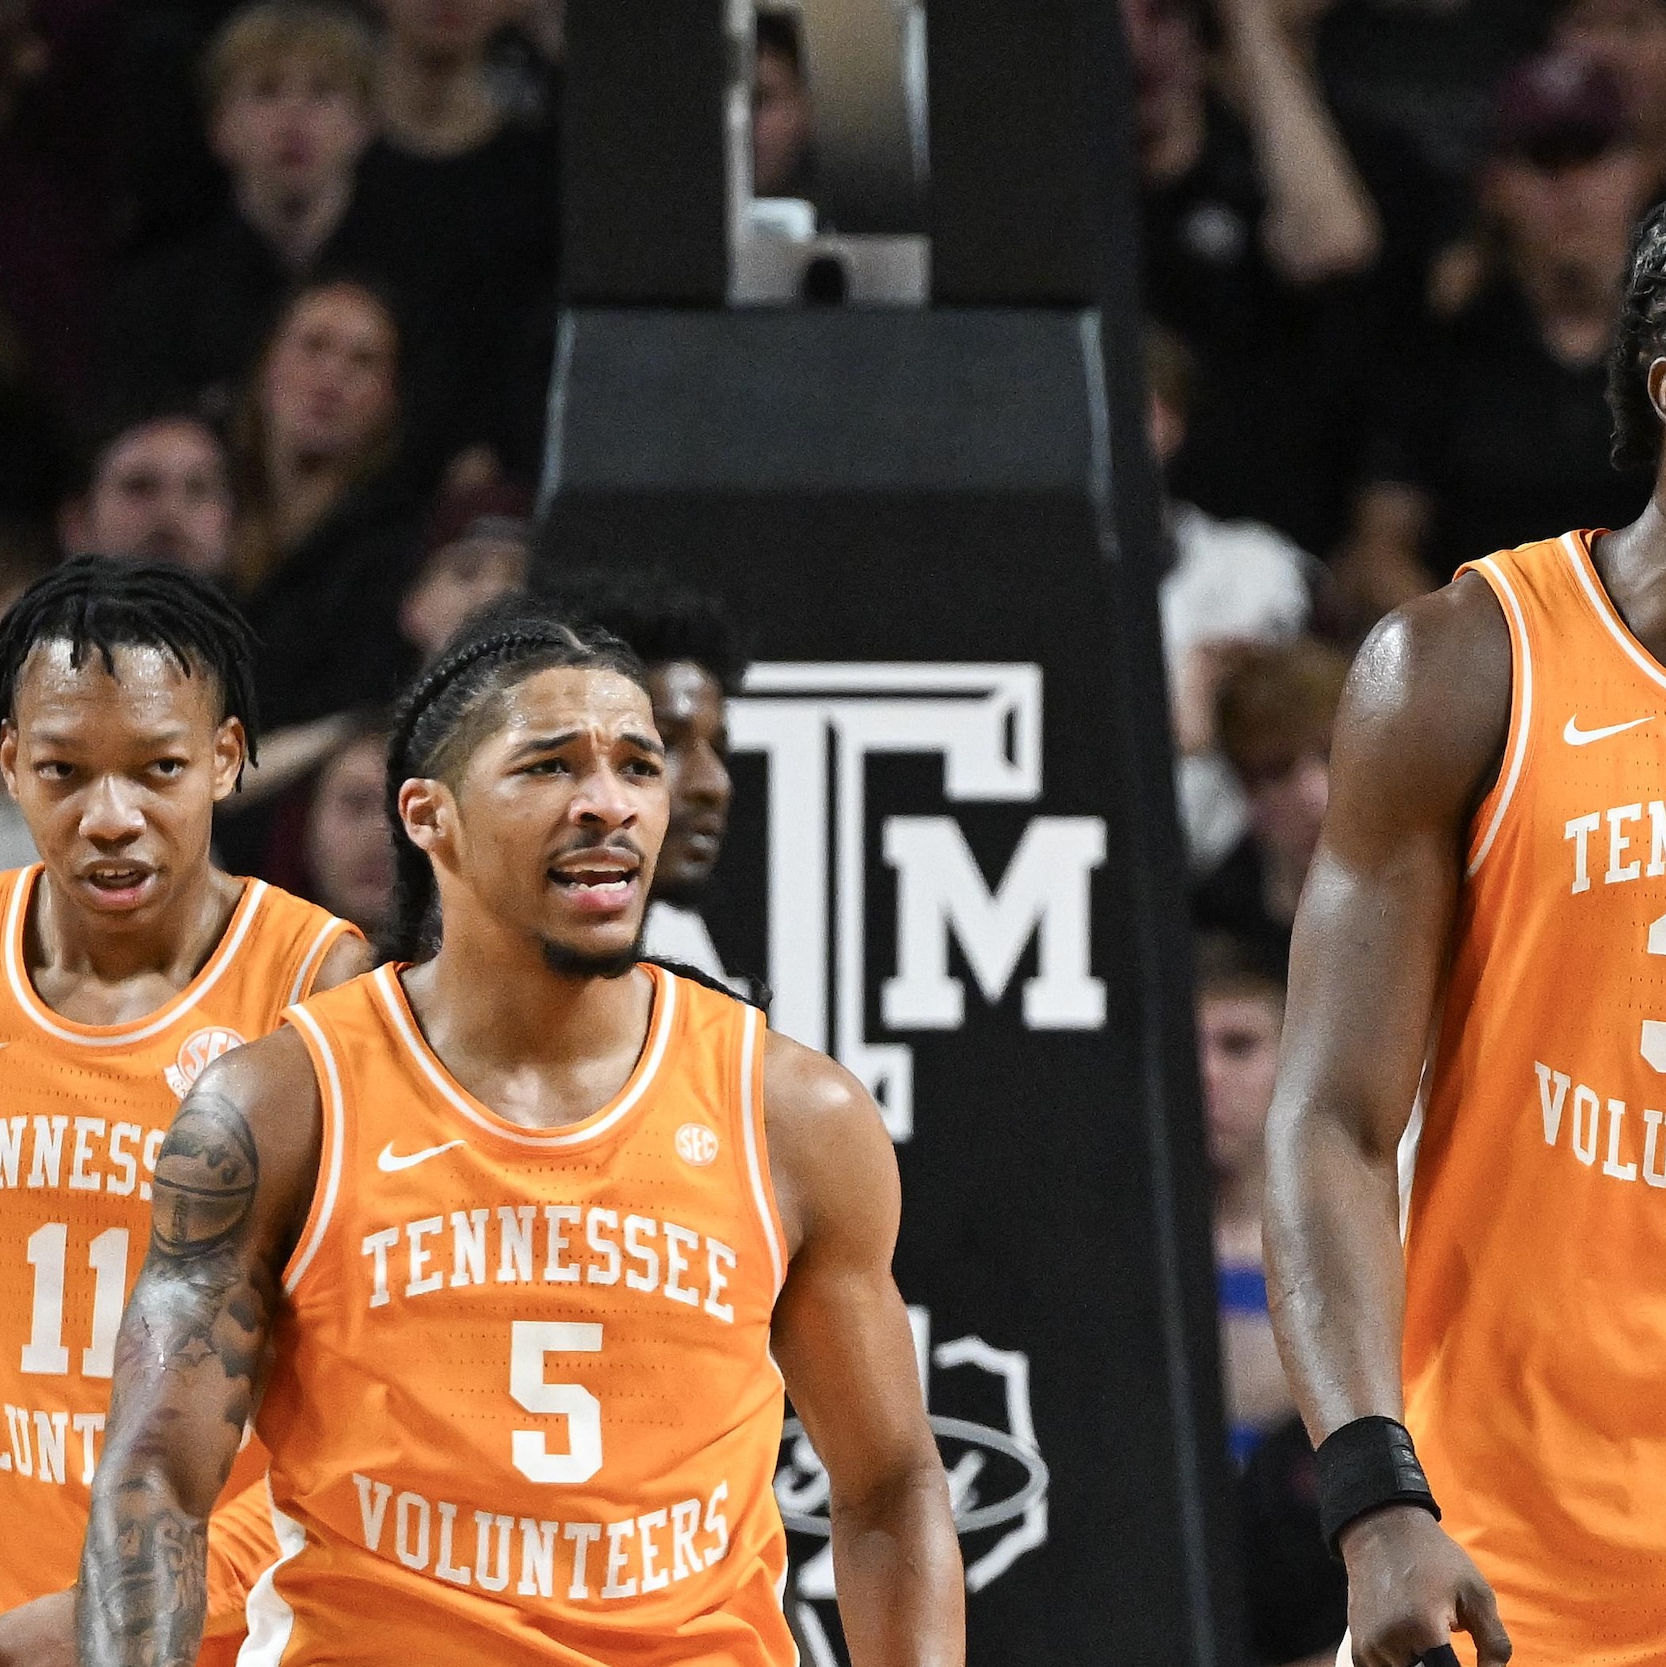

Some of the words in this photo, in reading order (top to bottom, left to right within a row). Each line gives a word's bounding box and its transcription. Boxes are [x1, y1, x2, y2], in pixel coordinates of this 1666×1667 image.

[677, 1125, 717, 1163] SEC
[20, 1222, 130, 1379] 11
[361, 1205, 737, 1323] TENNESSEE
[509, 1320, 604, 1485] 5
[353, 1474, 730, 1600] VOLUNTEERS
